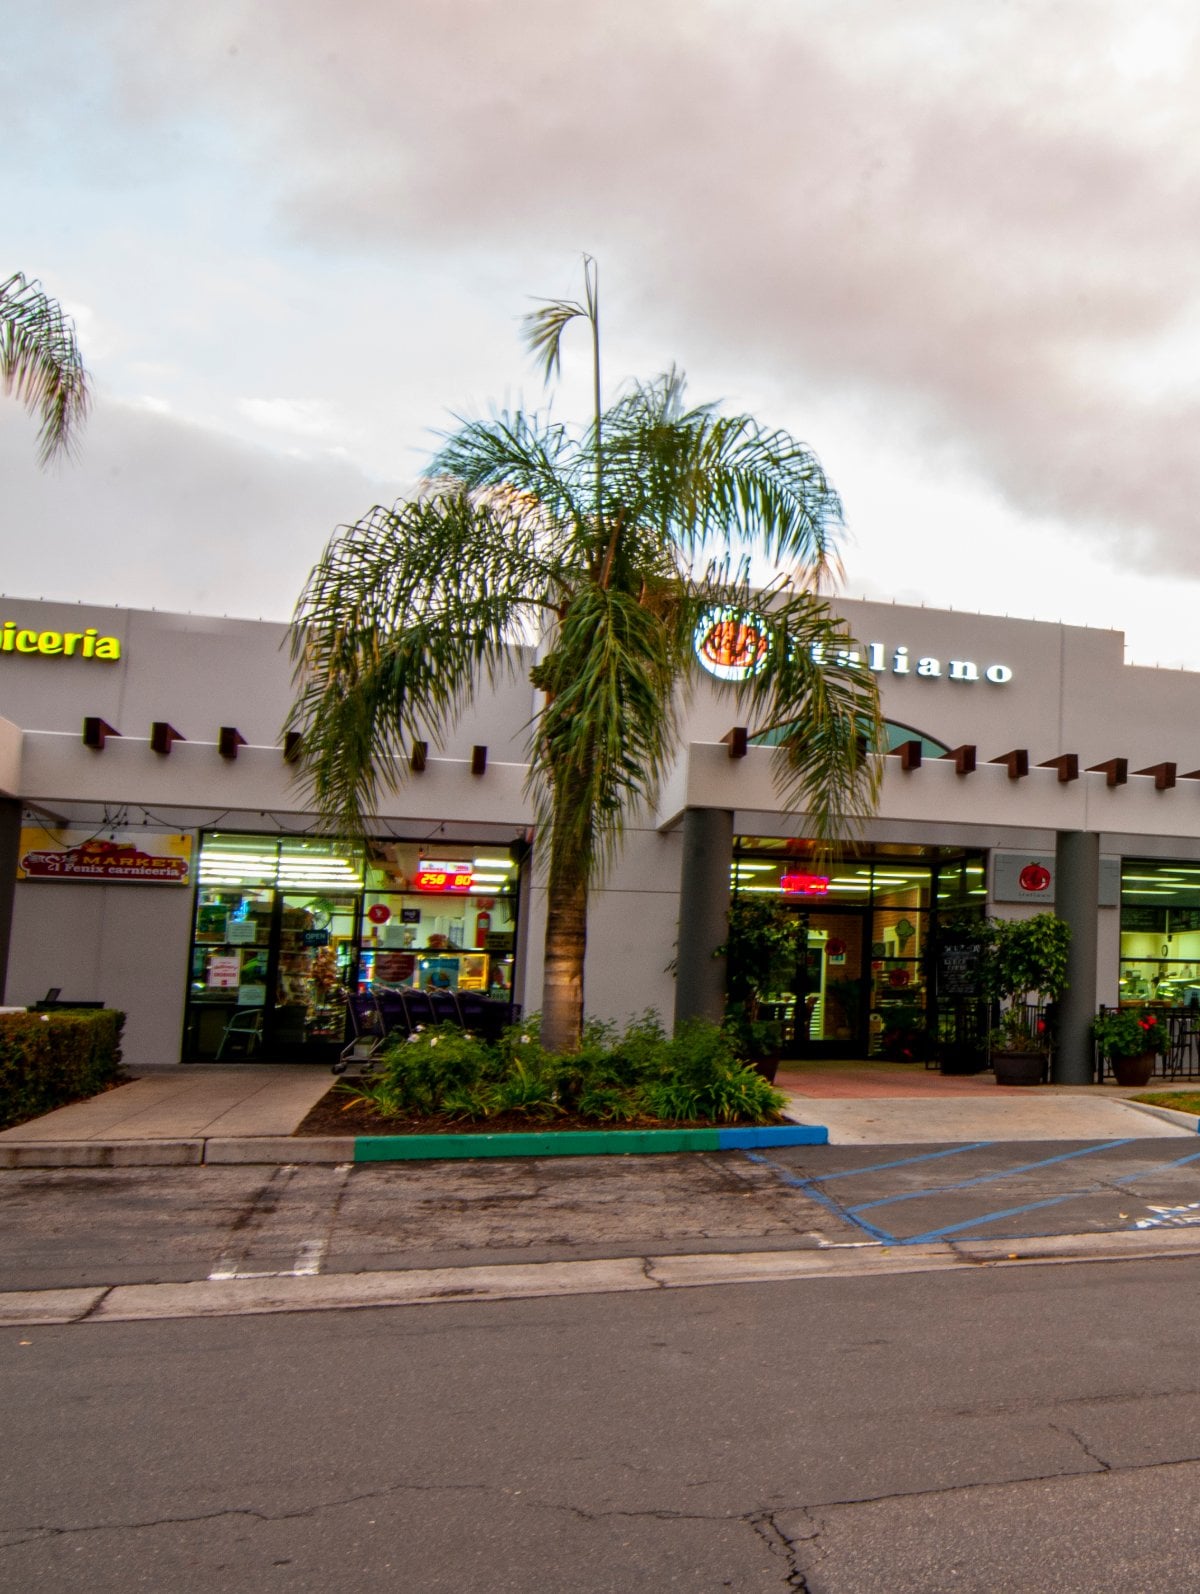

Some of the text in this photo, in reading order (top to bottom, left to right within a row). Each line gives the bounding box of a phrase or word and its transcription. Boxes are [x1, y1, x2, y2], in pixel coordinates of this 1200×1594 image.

[0, 621, 121, 660] iceria
[83, 856, 183, 867] MARKET
[64, 864, 104, 874] Fenix
[108, 866, 180, 876] carniceria
[305, 932, 326, 940] OPEN
